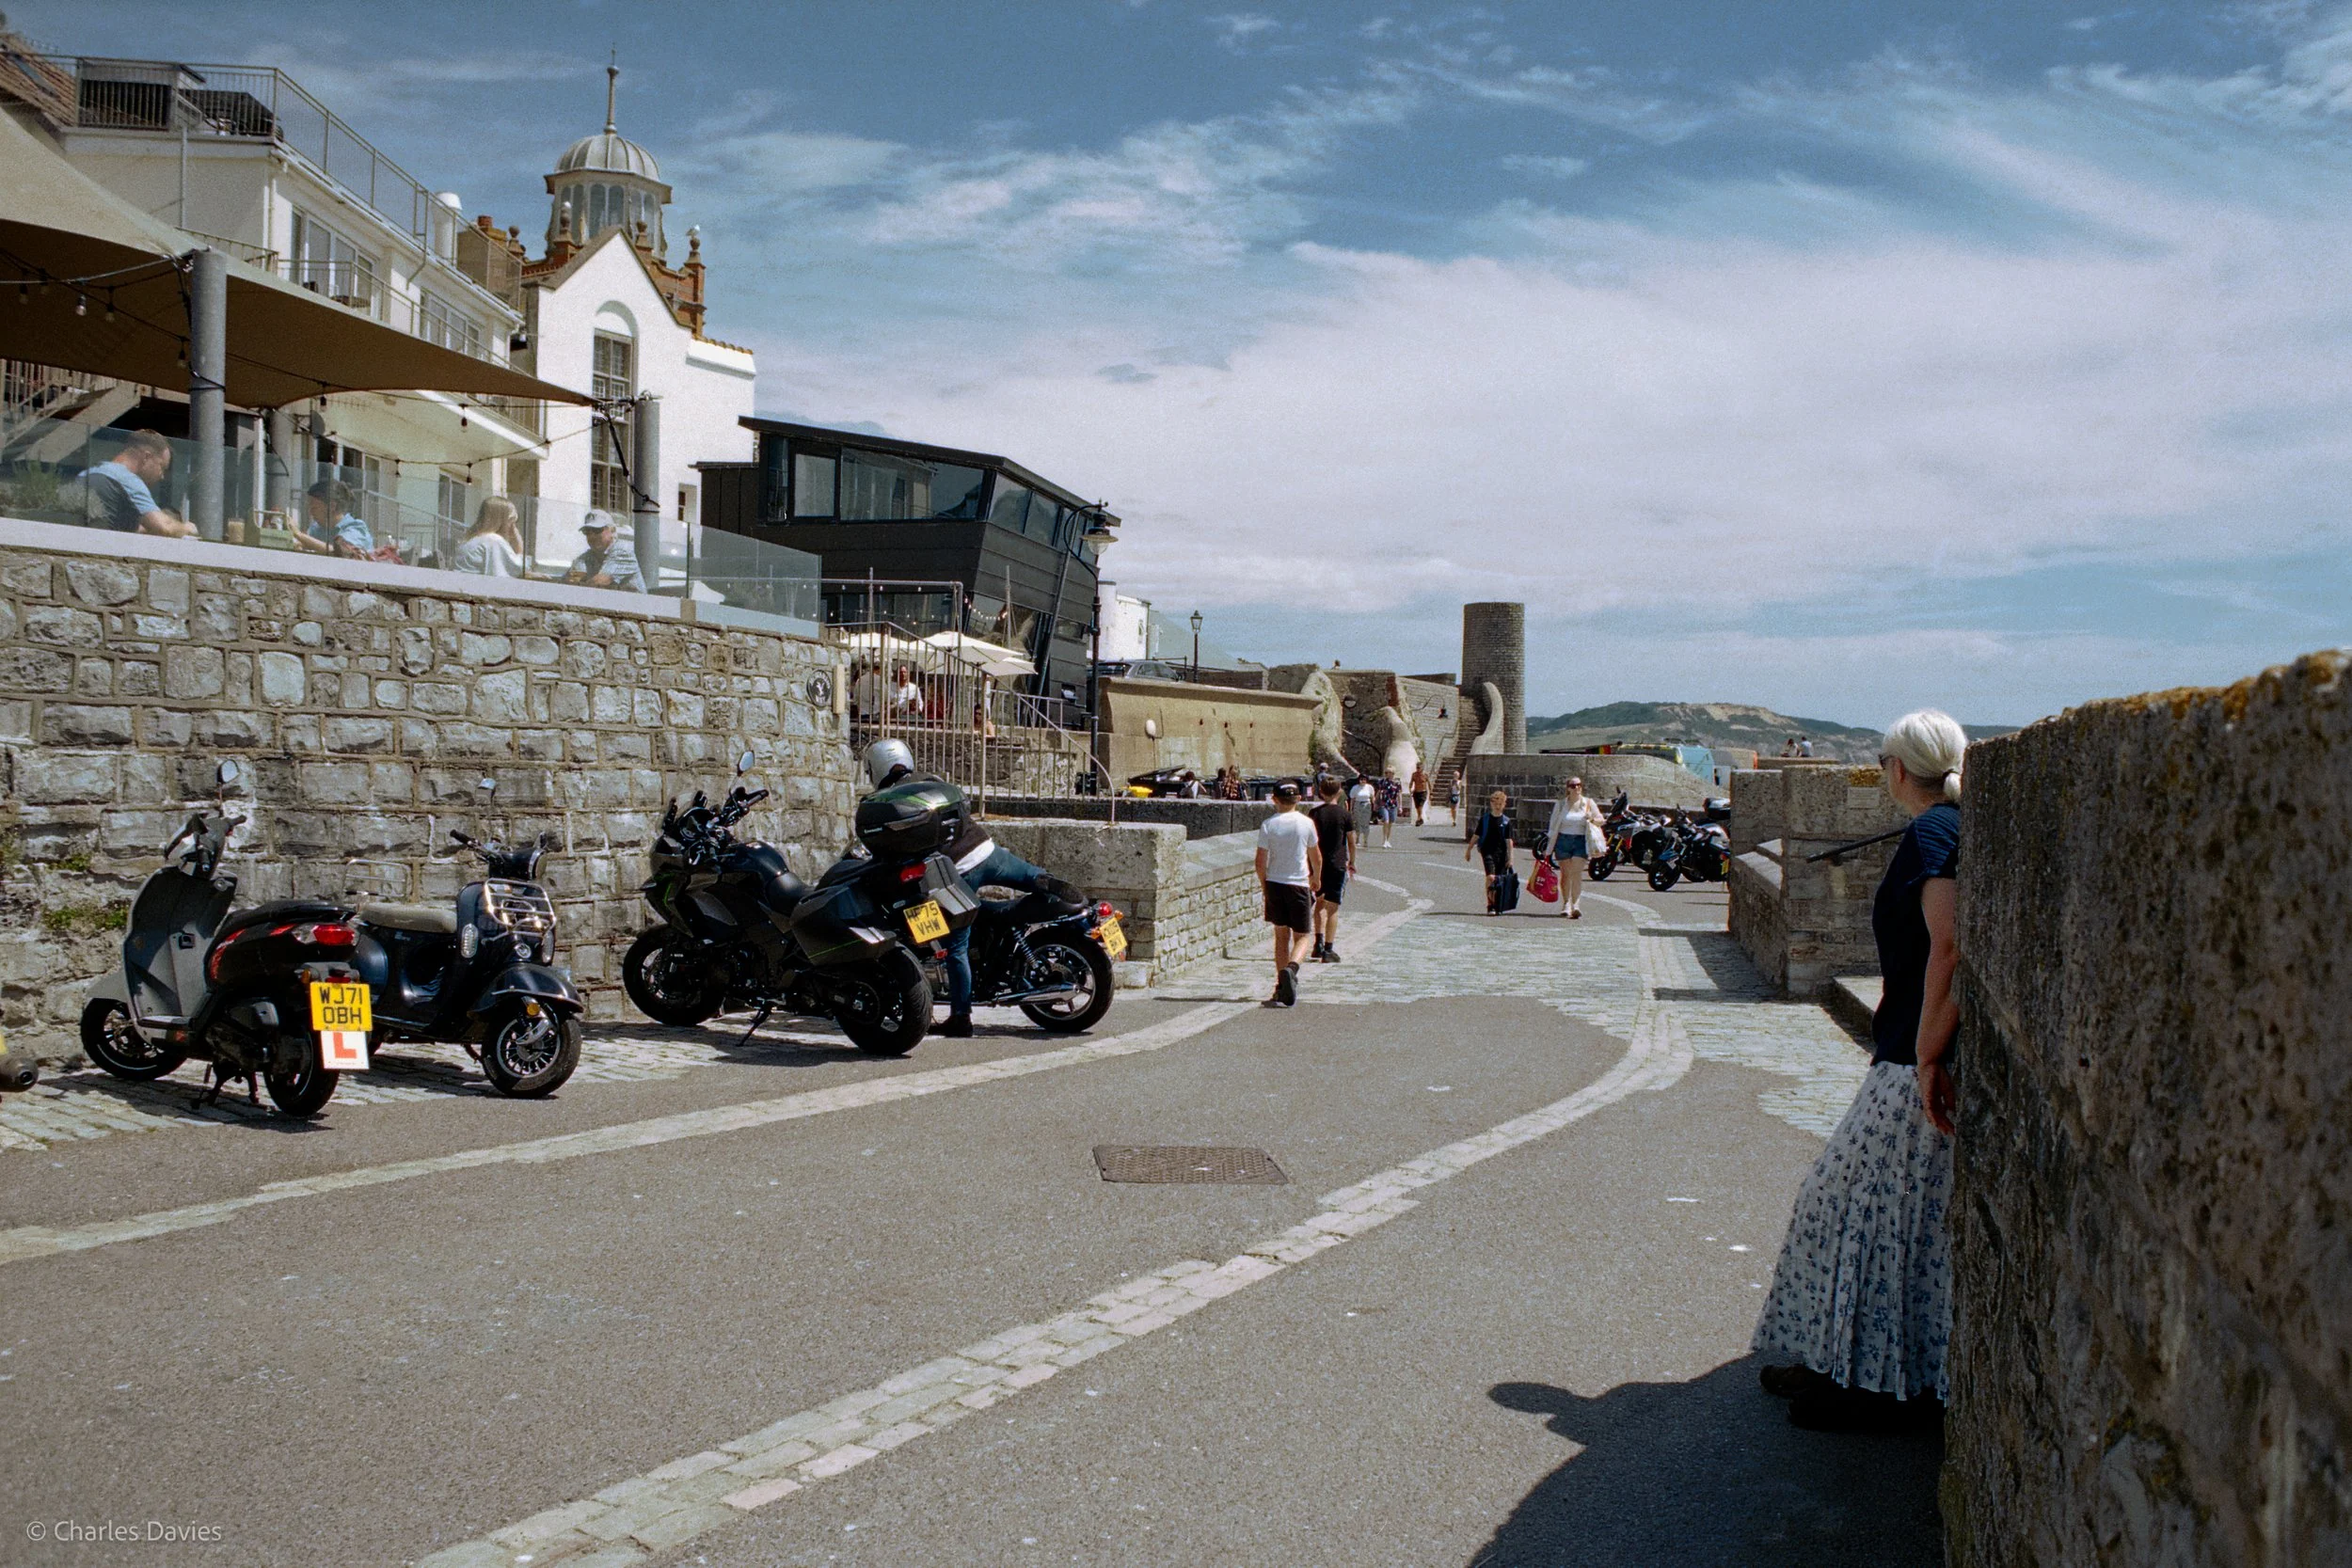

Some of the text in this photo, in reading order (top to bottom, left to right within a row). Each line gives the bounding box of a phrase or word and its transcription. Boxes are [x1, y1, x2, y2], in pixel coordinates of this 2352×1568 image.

[916, 918, 942, 936] VHW
[319, 986, 363, 1005] WJ71
[323, 1006, 363, 1024] OBH
[333, 1032, 358, 1059] L
